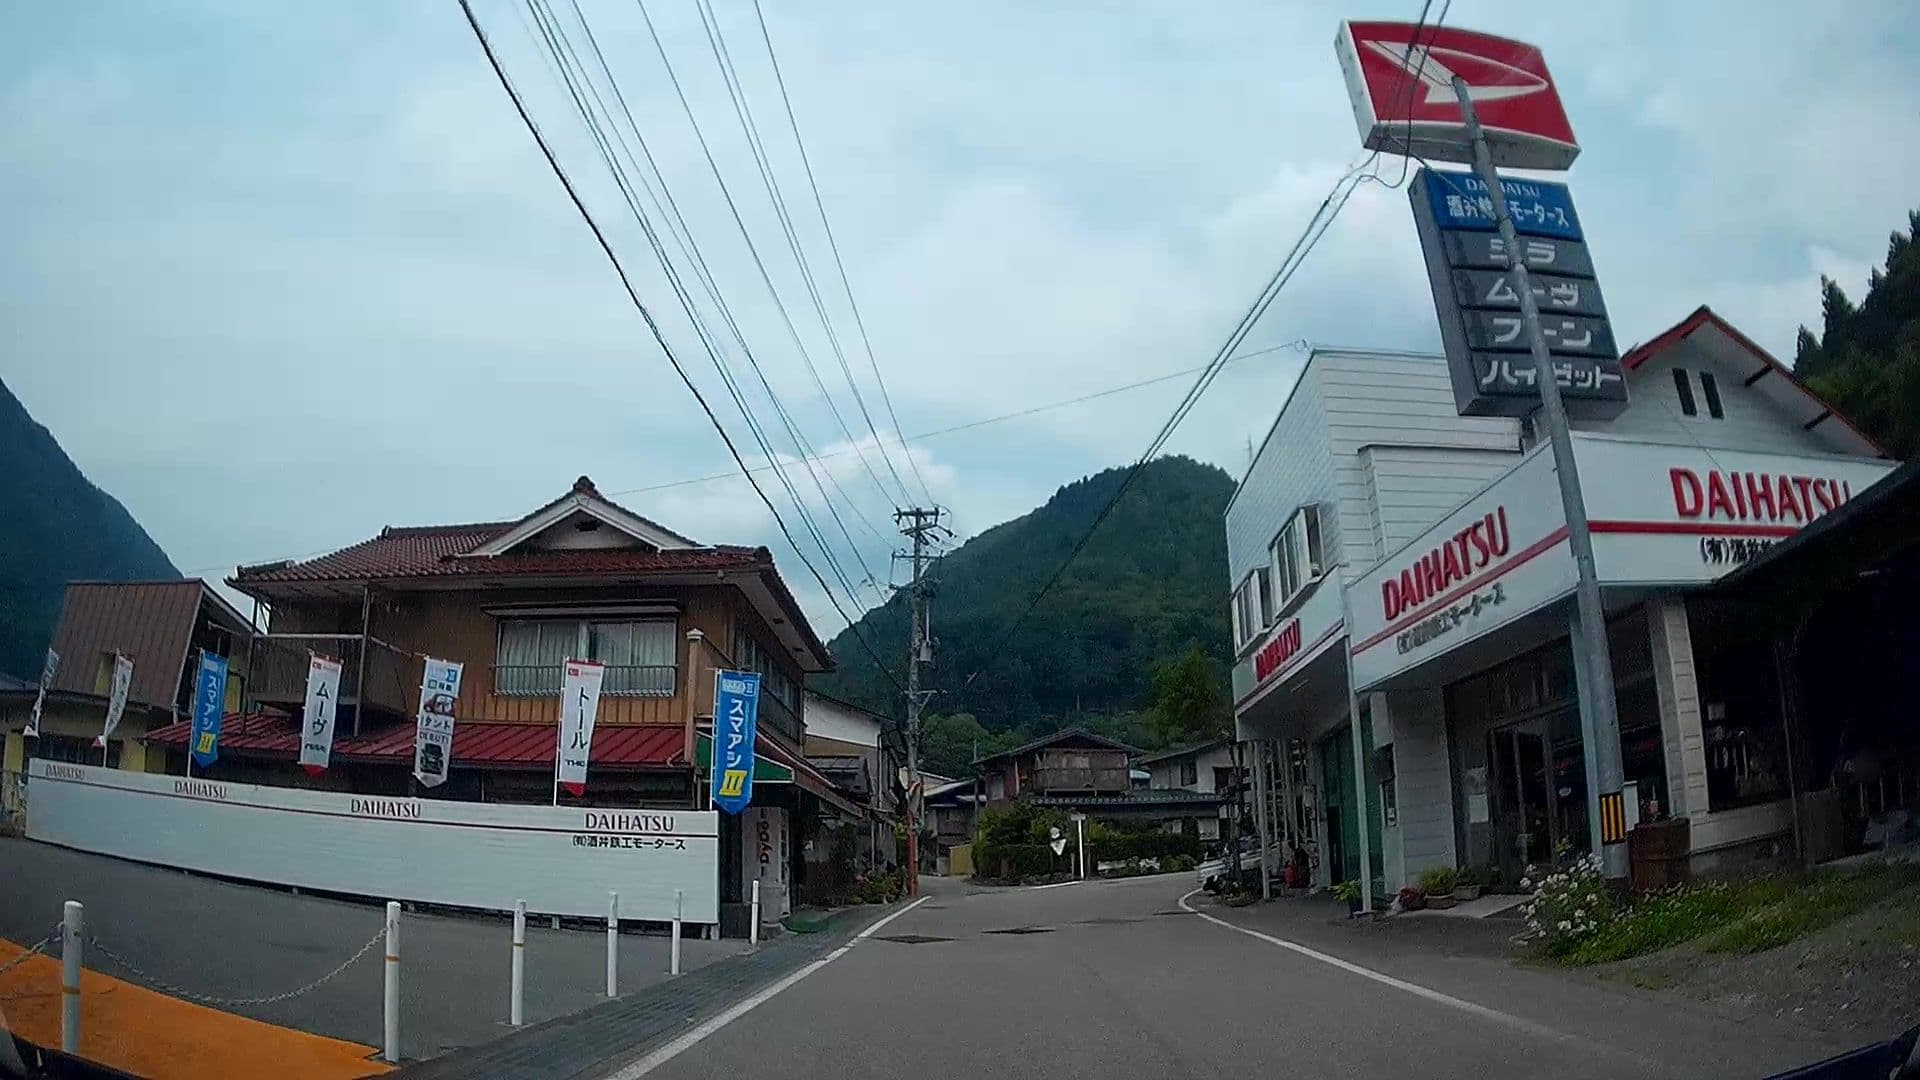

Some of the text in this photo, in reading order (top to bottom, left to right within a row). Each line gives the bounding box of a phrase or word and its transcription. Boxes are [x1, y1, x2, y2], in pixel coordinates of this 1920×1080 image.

[1465, 178, 1541, 197] DAATSU
[1446, 195, 1569, 227] 酒井鉄モータース
[1489, 238, 1555, 263] ミラ
[1481, 360, 1621, 388] ハイゼット
[1670, 467, 1850, 521] DAIHATSU
[1382, 505, 1510, 621] DAIHATSU
[1254, 617, 1301, 682] DAIHATSU
[312, 681, 329, 736] ムーヴ
[571, 686, 589, 749] トール
[45, 763, 86, 781] DAIHATSU
[174, 780, 228, 799] DAIHATSU
[350, 799, 421, 818] DAIHATSU
[585, 812, 675, 832] DAIHATSU
